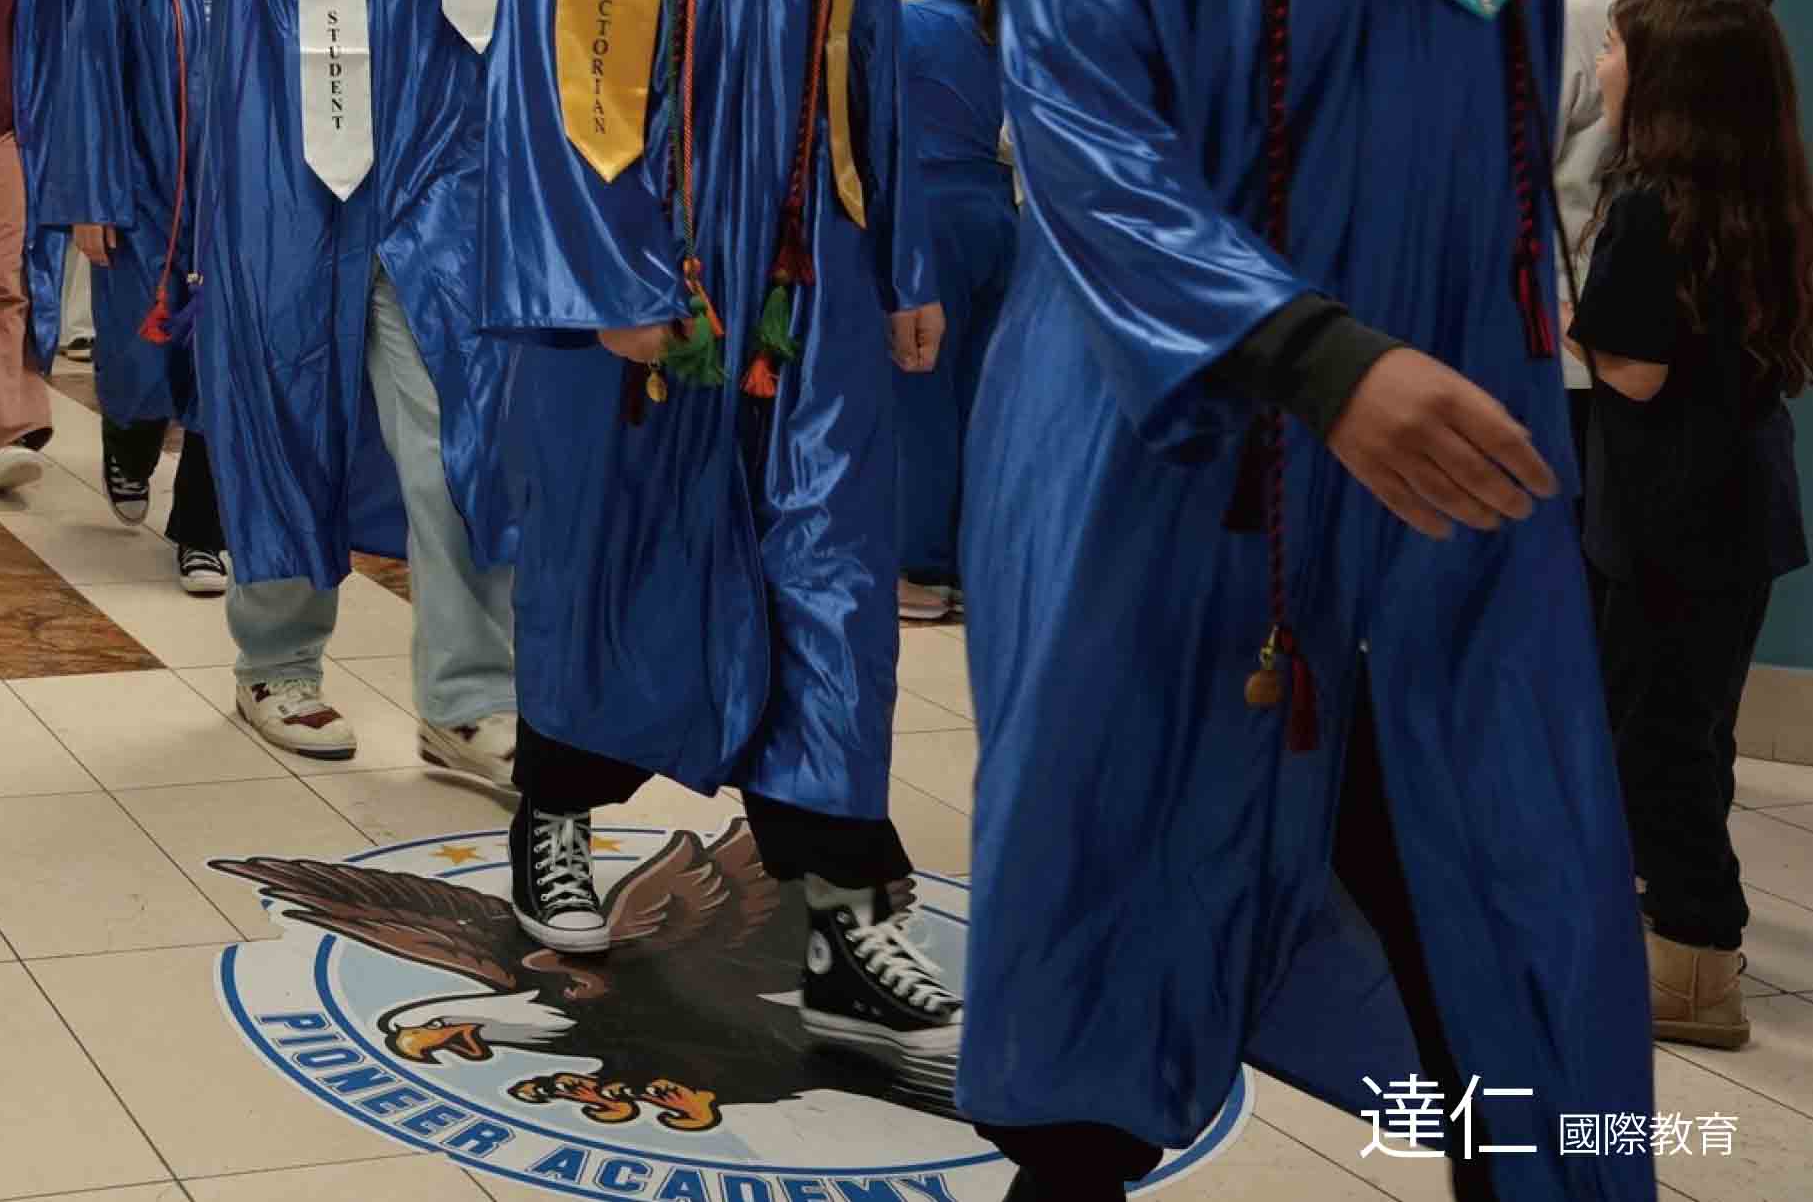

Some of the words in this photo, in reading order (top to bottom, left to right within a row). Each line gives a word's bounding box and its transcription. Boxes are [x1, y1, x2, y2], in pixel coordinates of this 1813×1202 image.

[325, 11, 345, 130] STUDENT
[256, 1012, 517, 1159] PIONEER
[524, 1143, 956, 1202] ACADEMY
